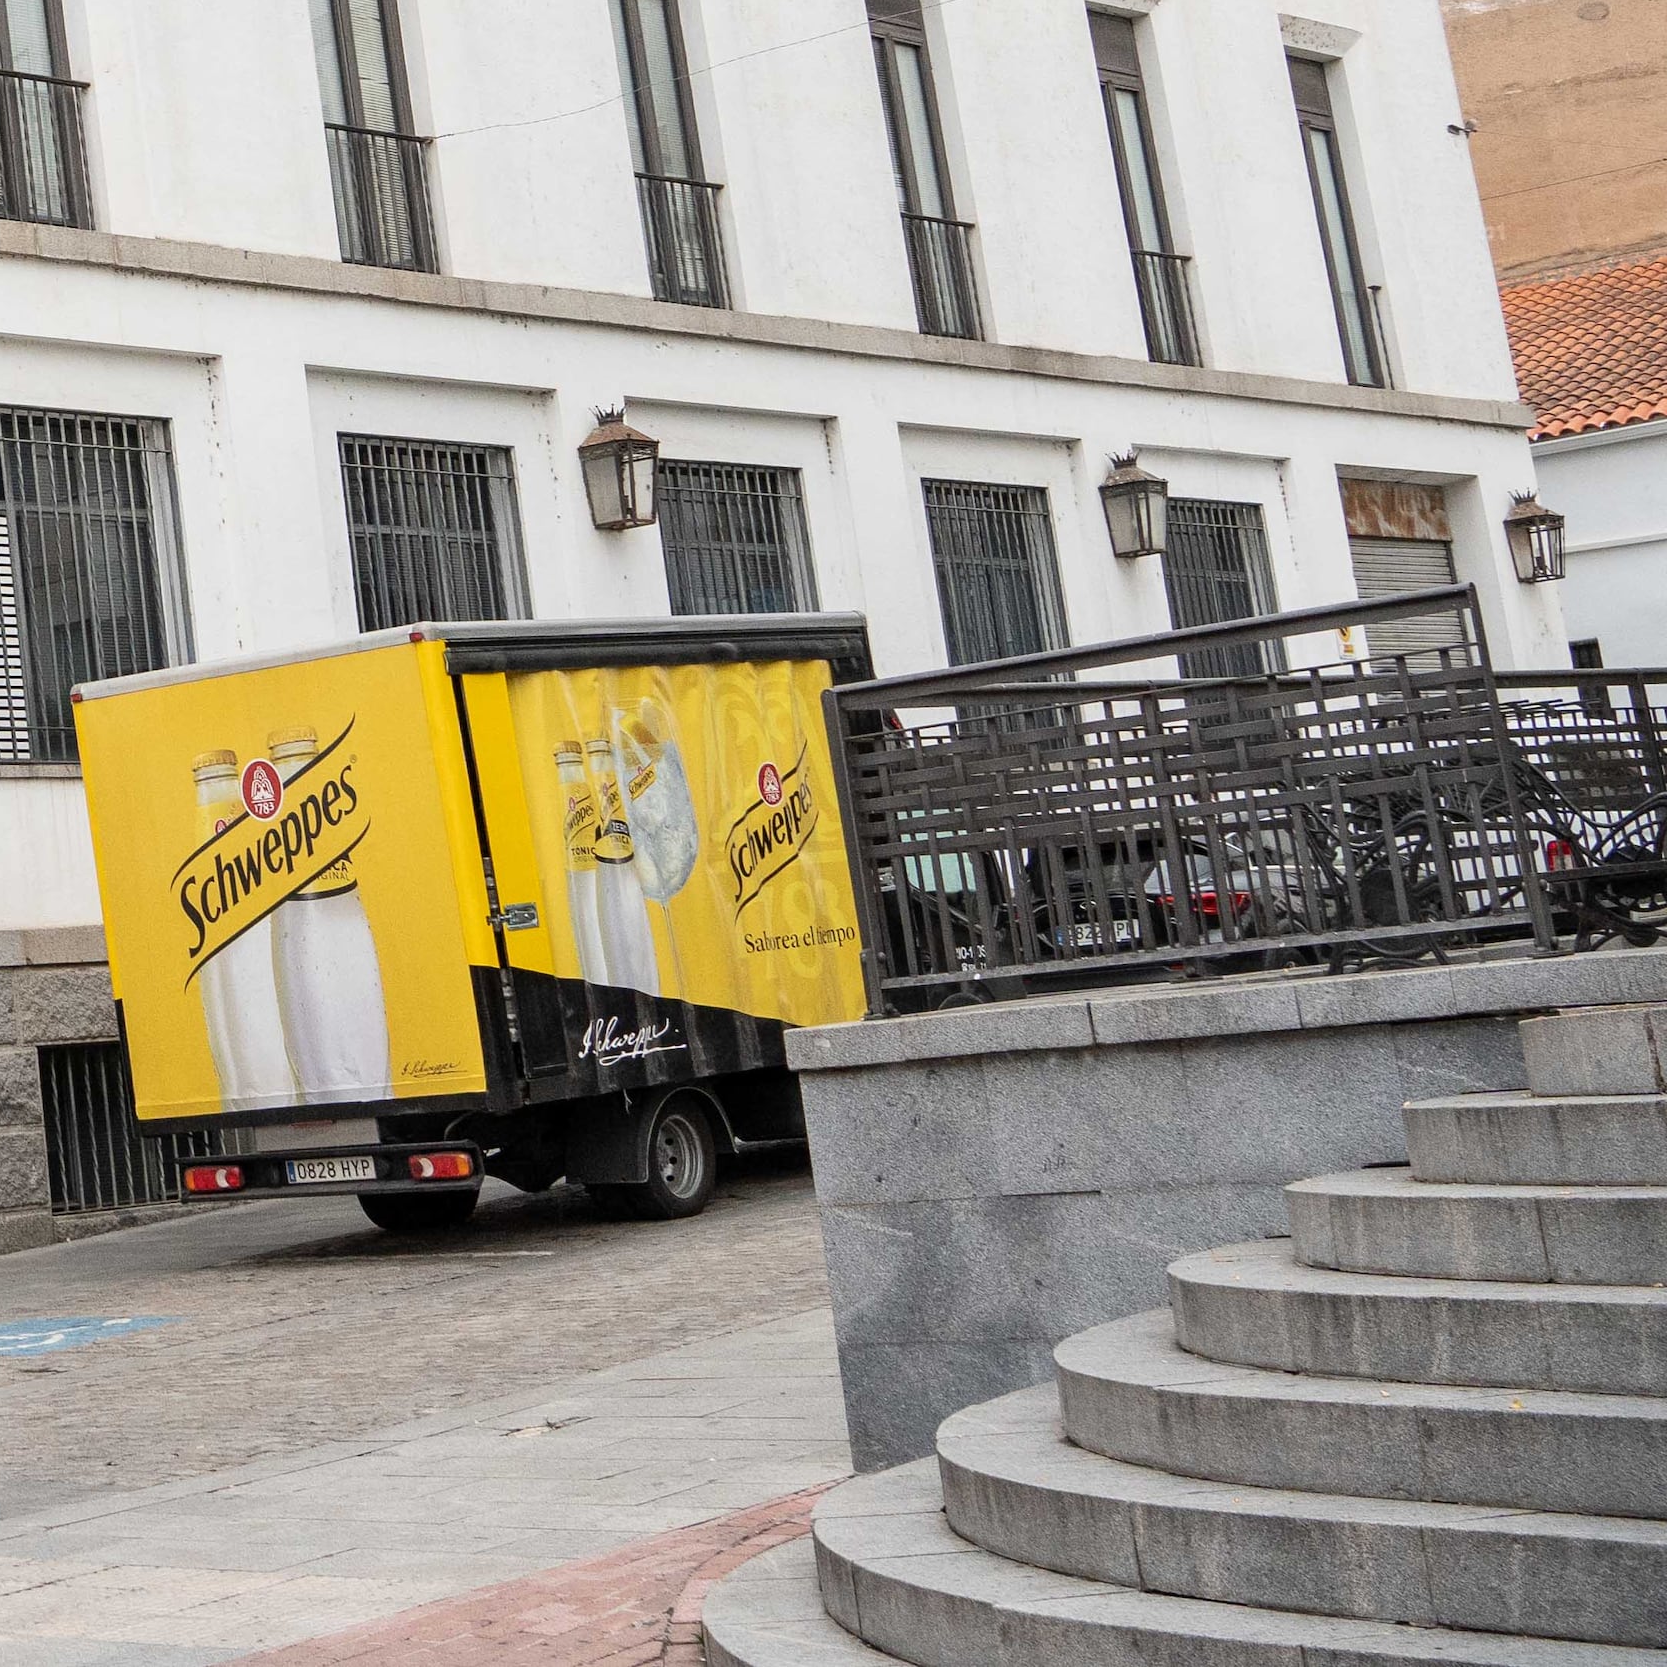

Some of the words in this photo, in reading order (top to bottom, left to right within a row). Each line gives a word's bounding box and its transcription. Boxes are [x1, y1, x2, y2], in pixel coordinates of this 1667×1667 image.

[254, 801, 275, 814] 1783
[729, 772, 814, 904] Schweppes
[180, 765, 358, 959] Schweppes
[744, 933, 799, 954] Saborea
[803, 926, 816, 945] el
[297, 1161, 336, 1180] 0828
[340, 1159, 370, 1178] HYP
